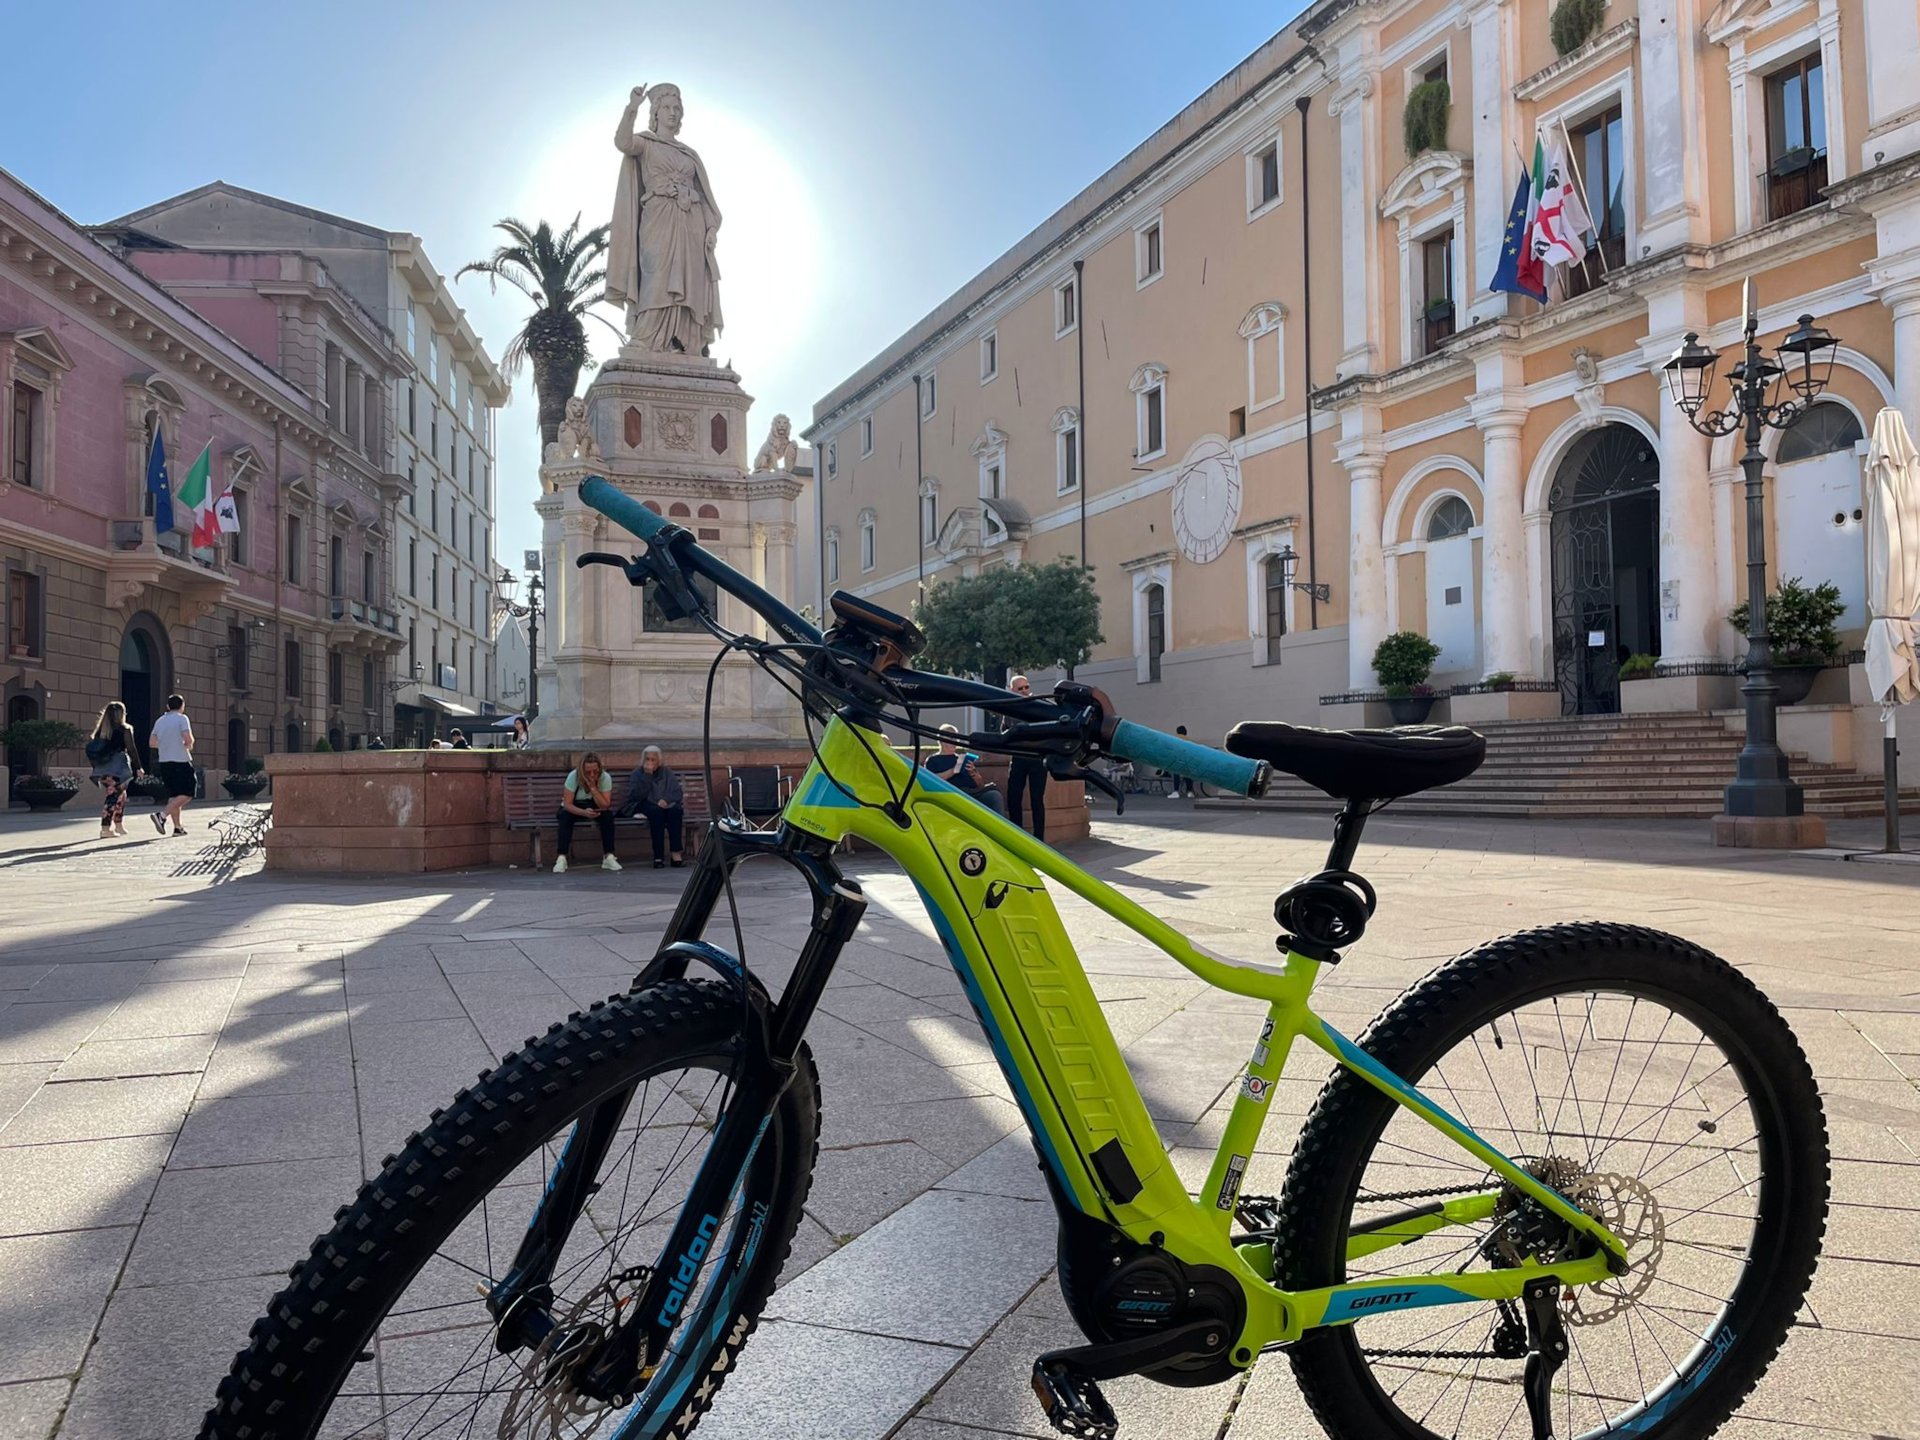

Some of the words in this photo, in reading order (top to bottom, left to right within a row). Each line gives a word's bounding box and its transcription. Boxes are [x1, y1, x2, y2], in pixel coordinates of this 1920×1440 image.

[781, 623, 813, 645] CONNEC
[1002, 914, 1134, 1149] GIANT
[657, 1213, 718, 1328] raidon
[1350, 1291, 1418, 1309] GIANT
[1117, 1300, 1171, 1312] GIANT
[665, 1314, 749, 1440] MAXX
